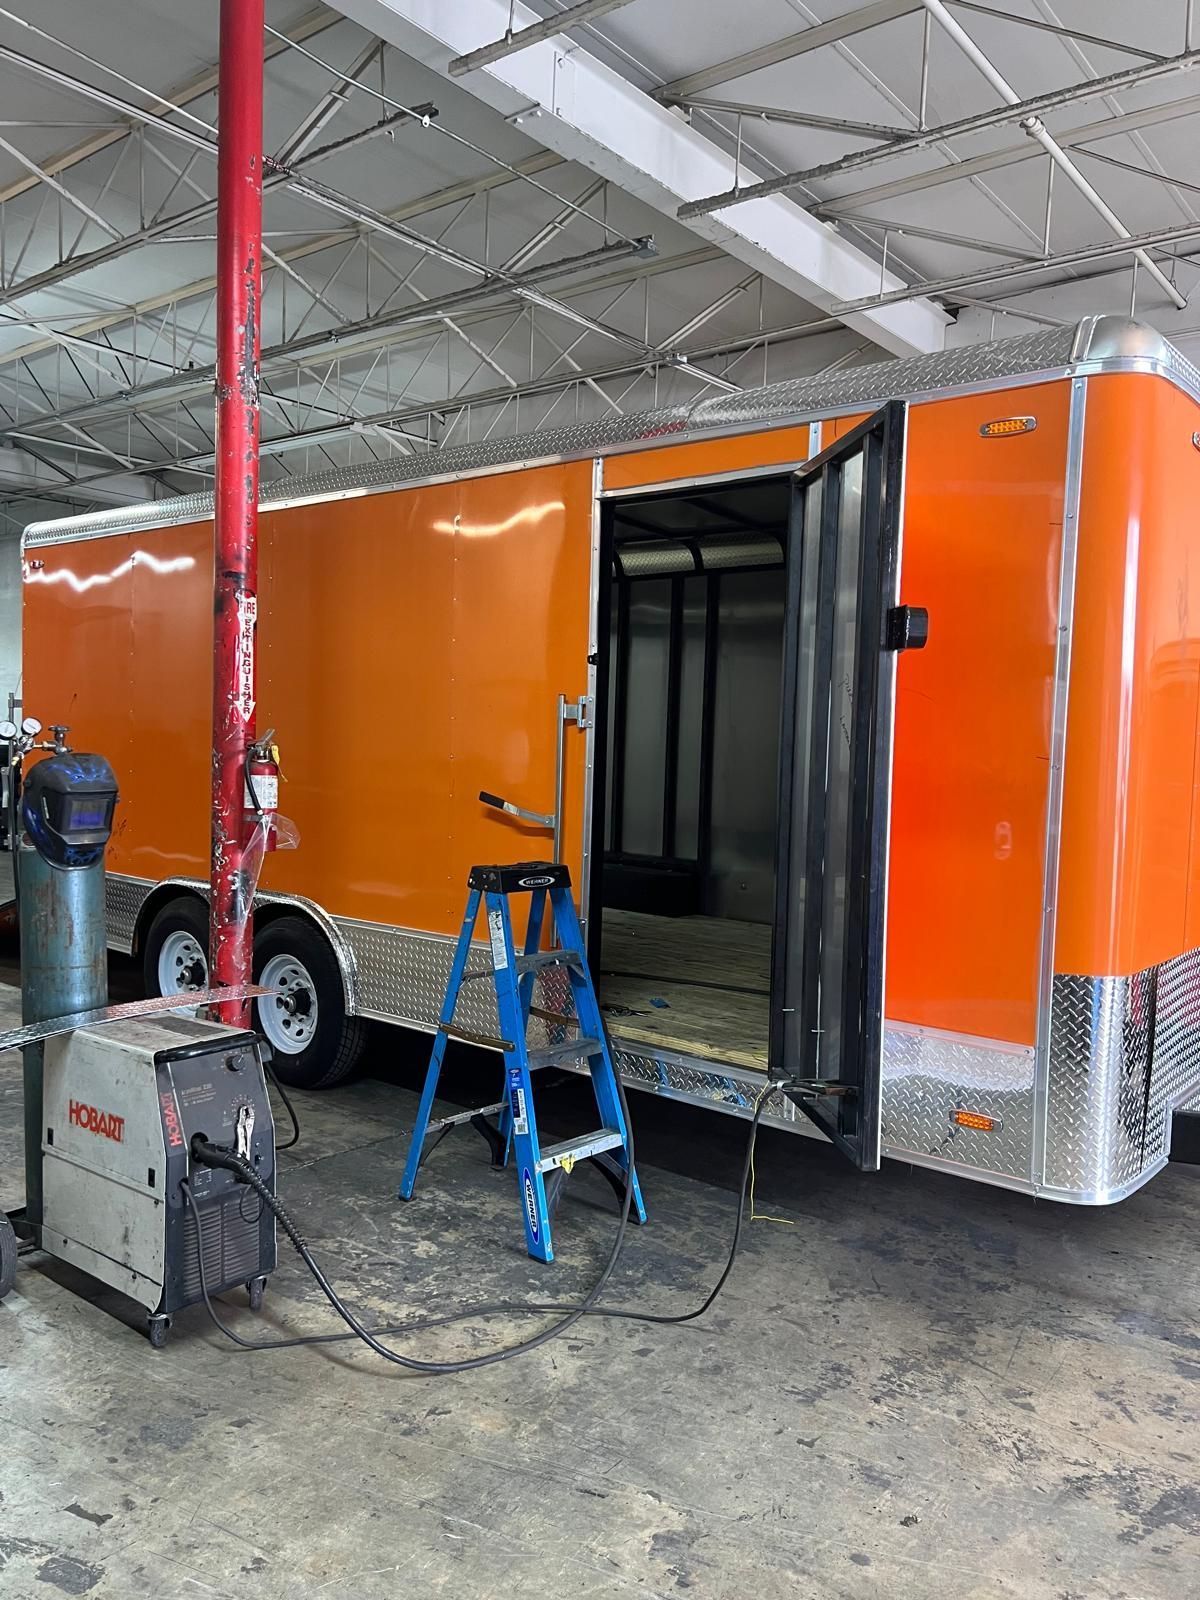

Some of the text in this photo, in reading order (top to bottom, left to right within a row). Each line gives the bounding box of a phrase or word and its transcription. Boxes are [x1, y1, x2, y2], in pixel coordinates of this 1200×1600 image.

[243, 618, 252, 714] EXTINGUISHER
[68, 1098, 125, 1143] HOBART
[160, 1091, 183, 1147] HOBART
[526, 1184, 538, 1228] WERNER
